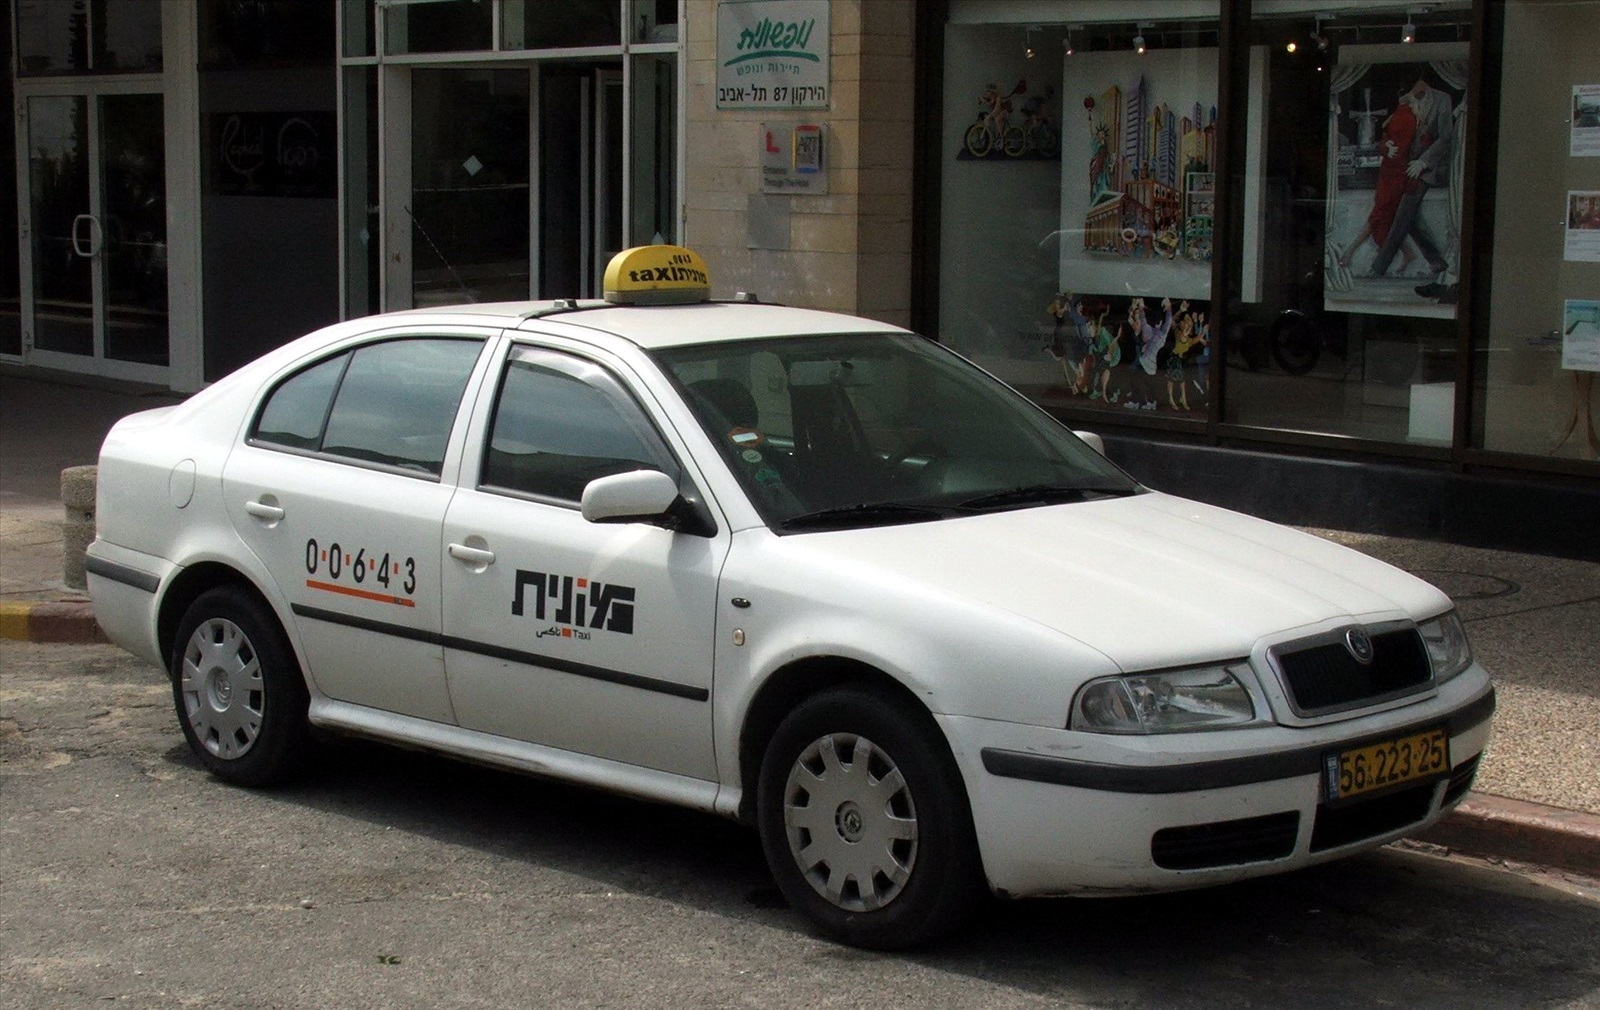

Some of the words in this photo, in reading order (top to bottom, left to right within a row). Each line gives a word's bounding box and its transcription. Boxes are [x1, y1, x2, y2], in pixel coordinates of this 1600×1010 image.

[736, 64, 764, 76] ונופש
[768, 62, 801, 75] תיירות
[719, 83, 767, 102] תל-אביב
[773, 86, 788, 102] 87
[791, 86, 826, 105] הירקון
[511, 569, 636, 635] מונית
[573, 629, 591, 641] Taxi
